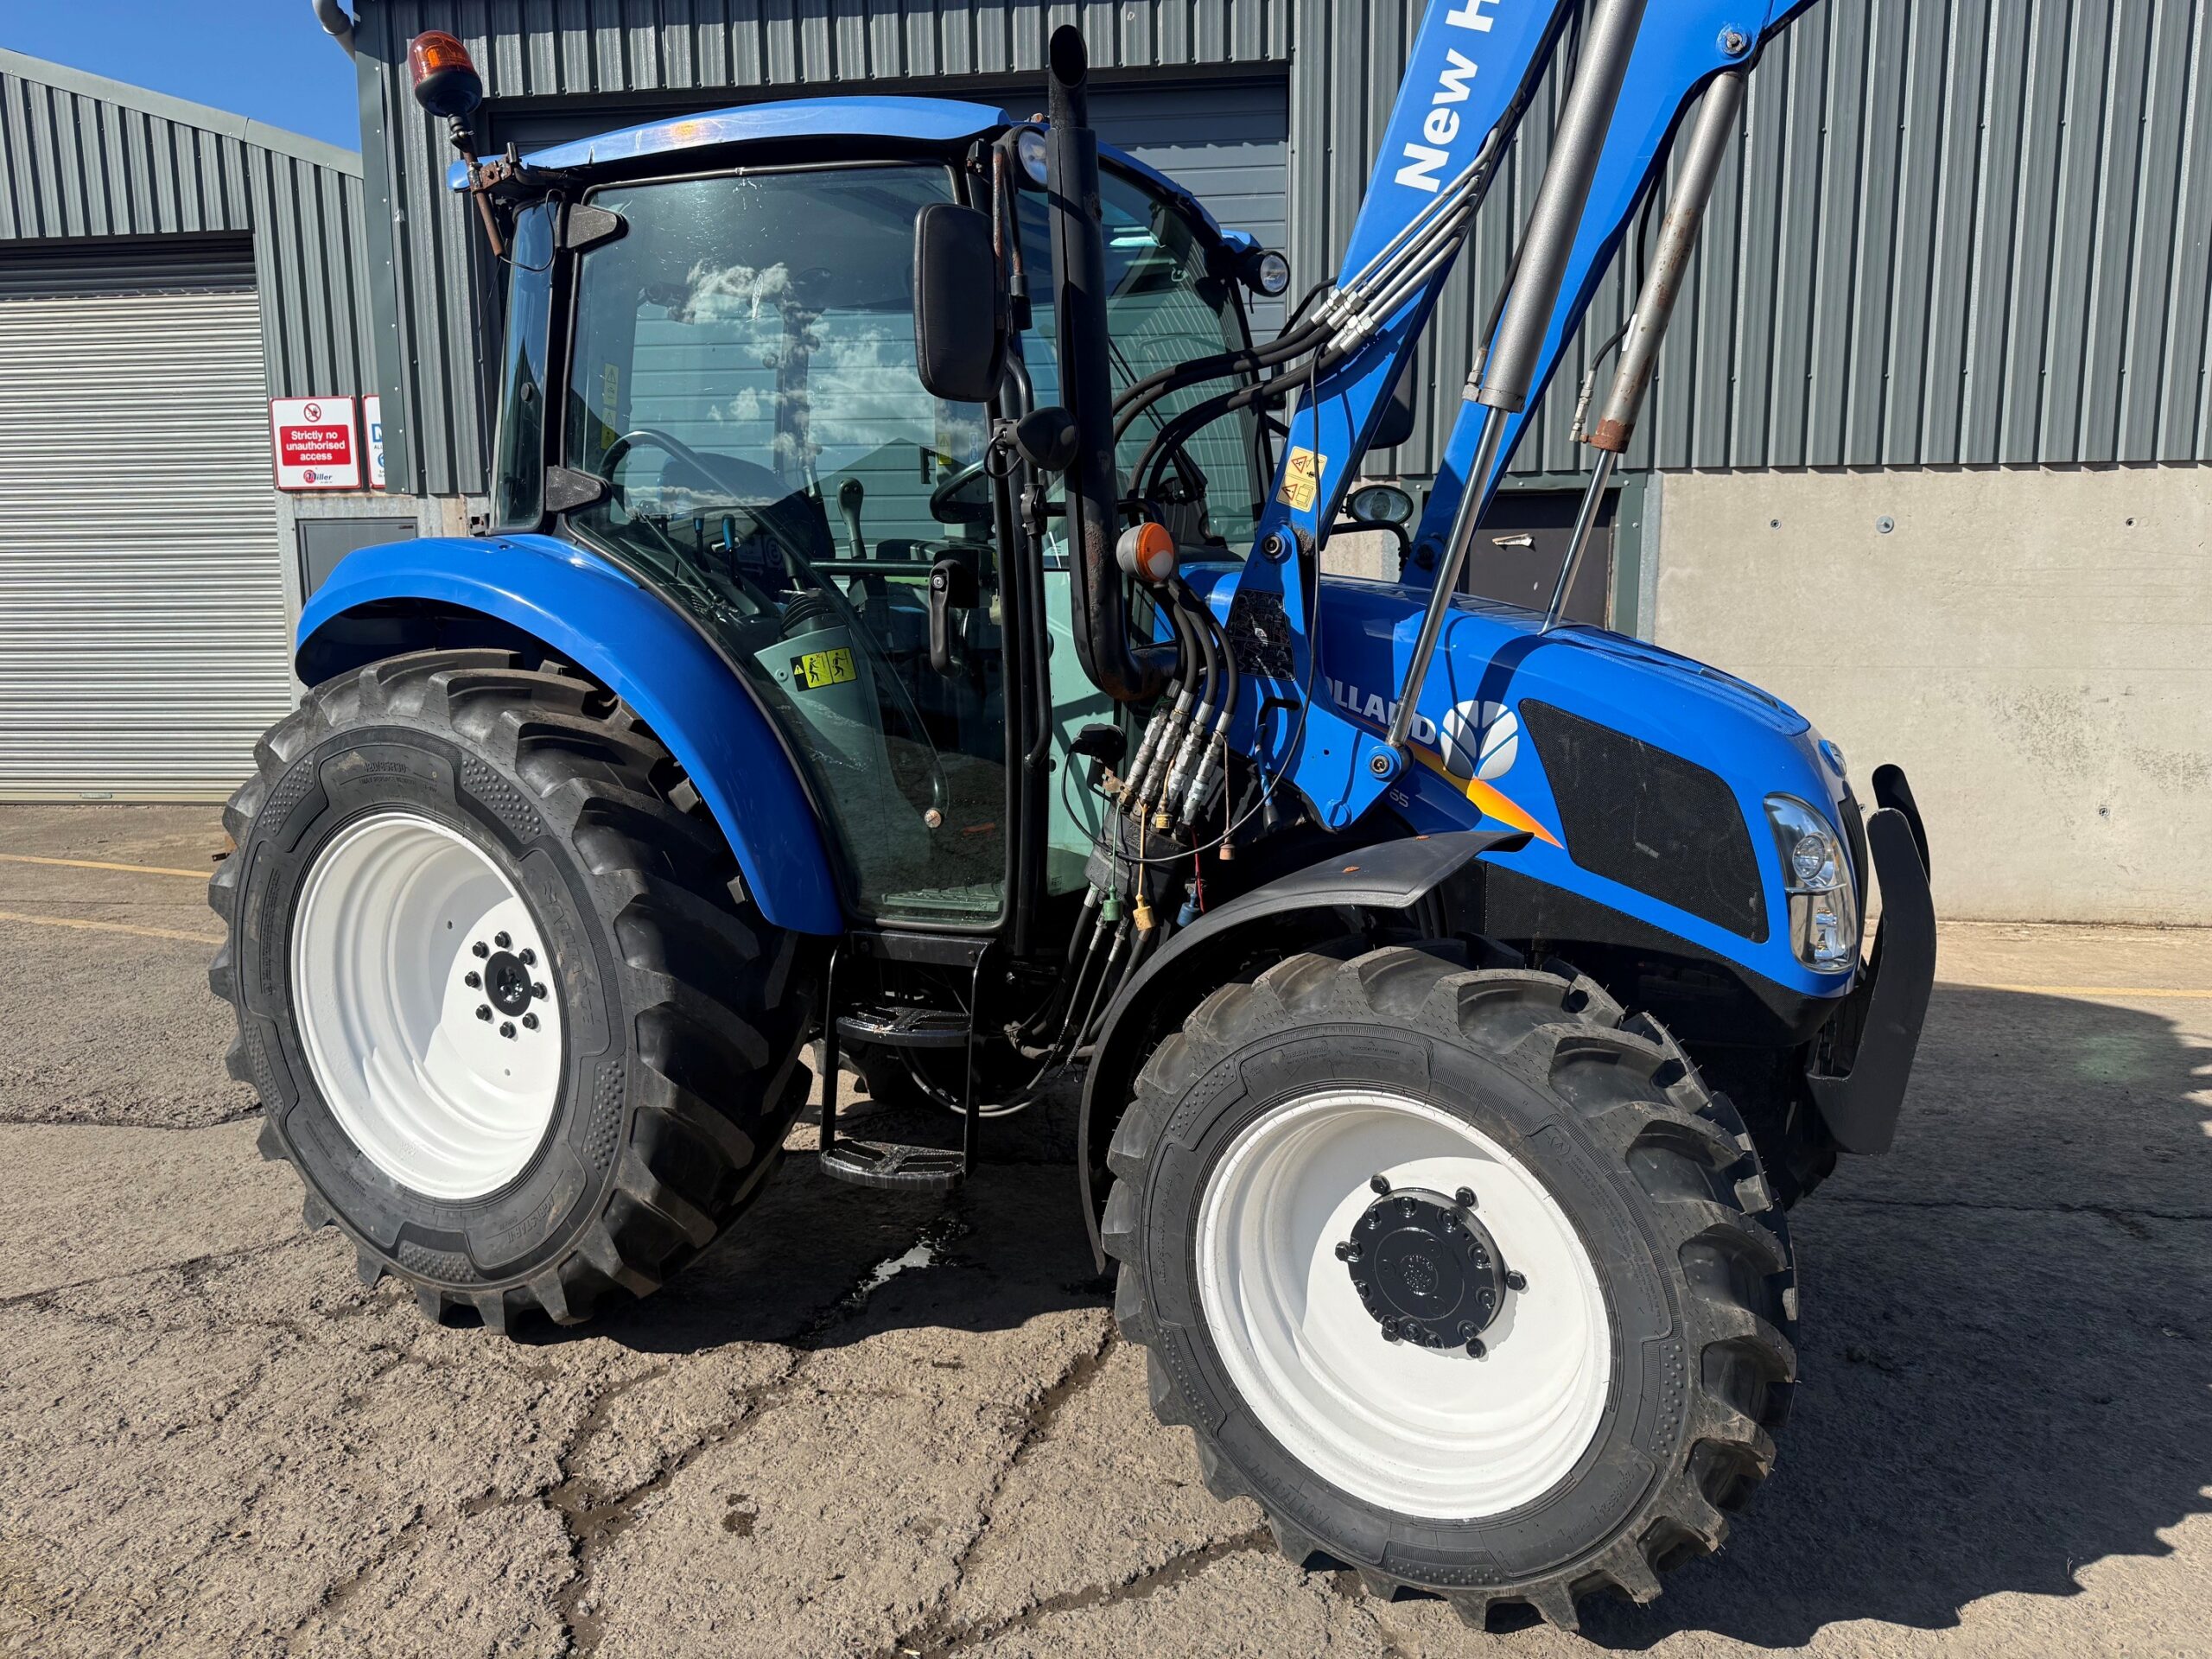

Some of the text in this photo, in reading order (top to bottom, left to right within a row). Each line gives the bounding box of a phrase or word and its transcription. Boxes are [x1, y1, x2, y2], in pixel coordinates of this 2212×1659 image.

[1394, 48, 1478, 193] New
[290, 430, 338, 442] Strictly no
[286, 440, 346, 451] unauthorised
[300, 452, 333, 461] access
